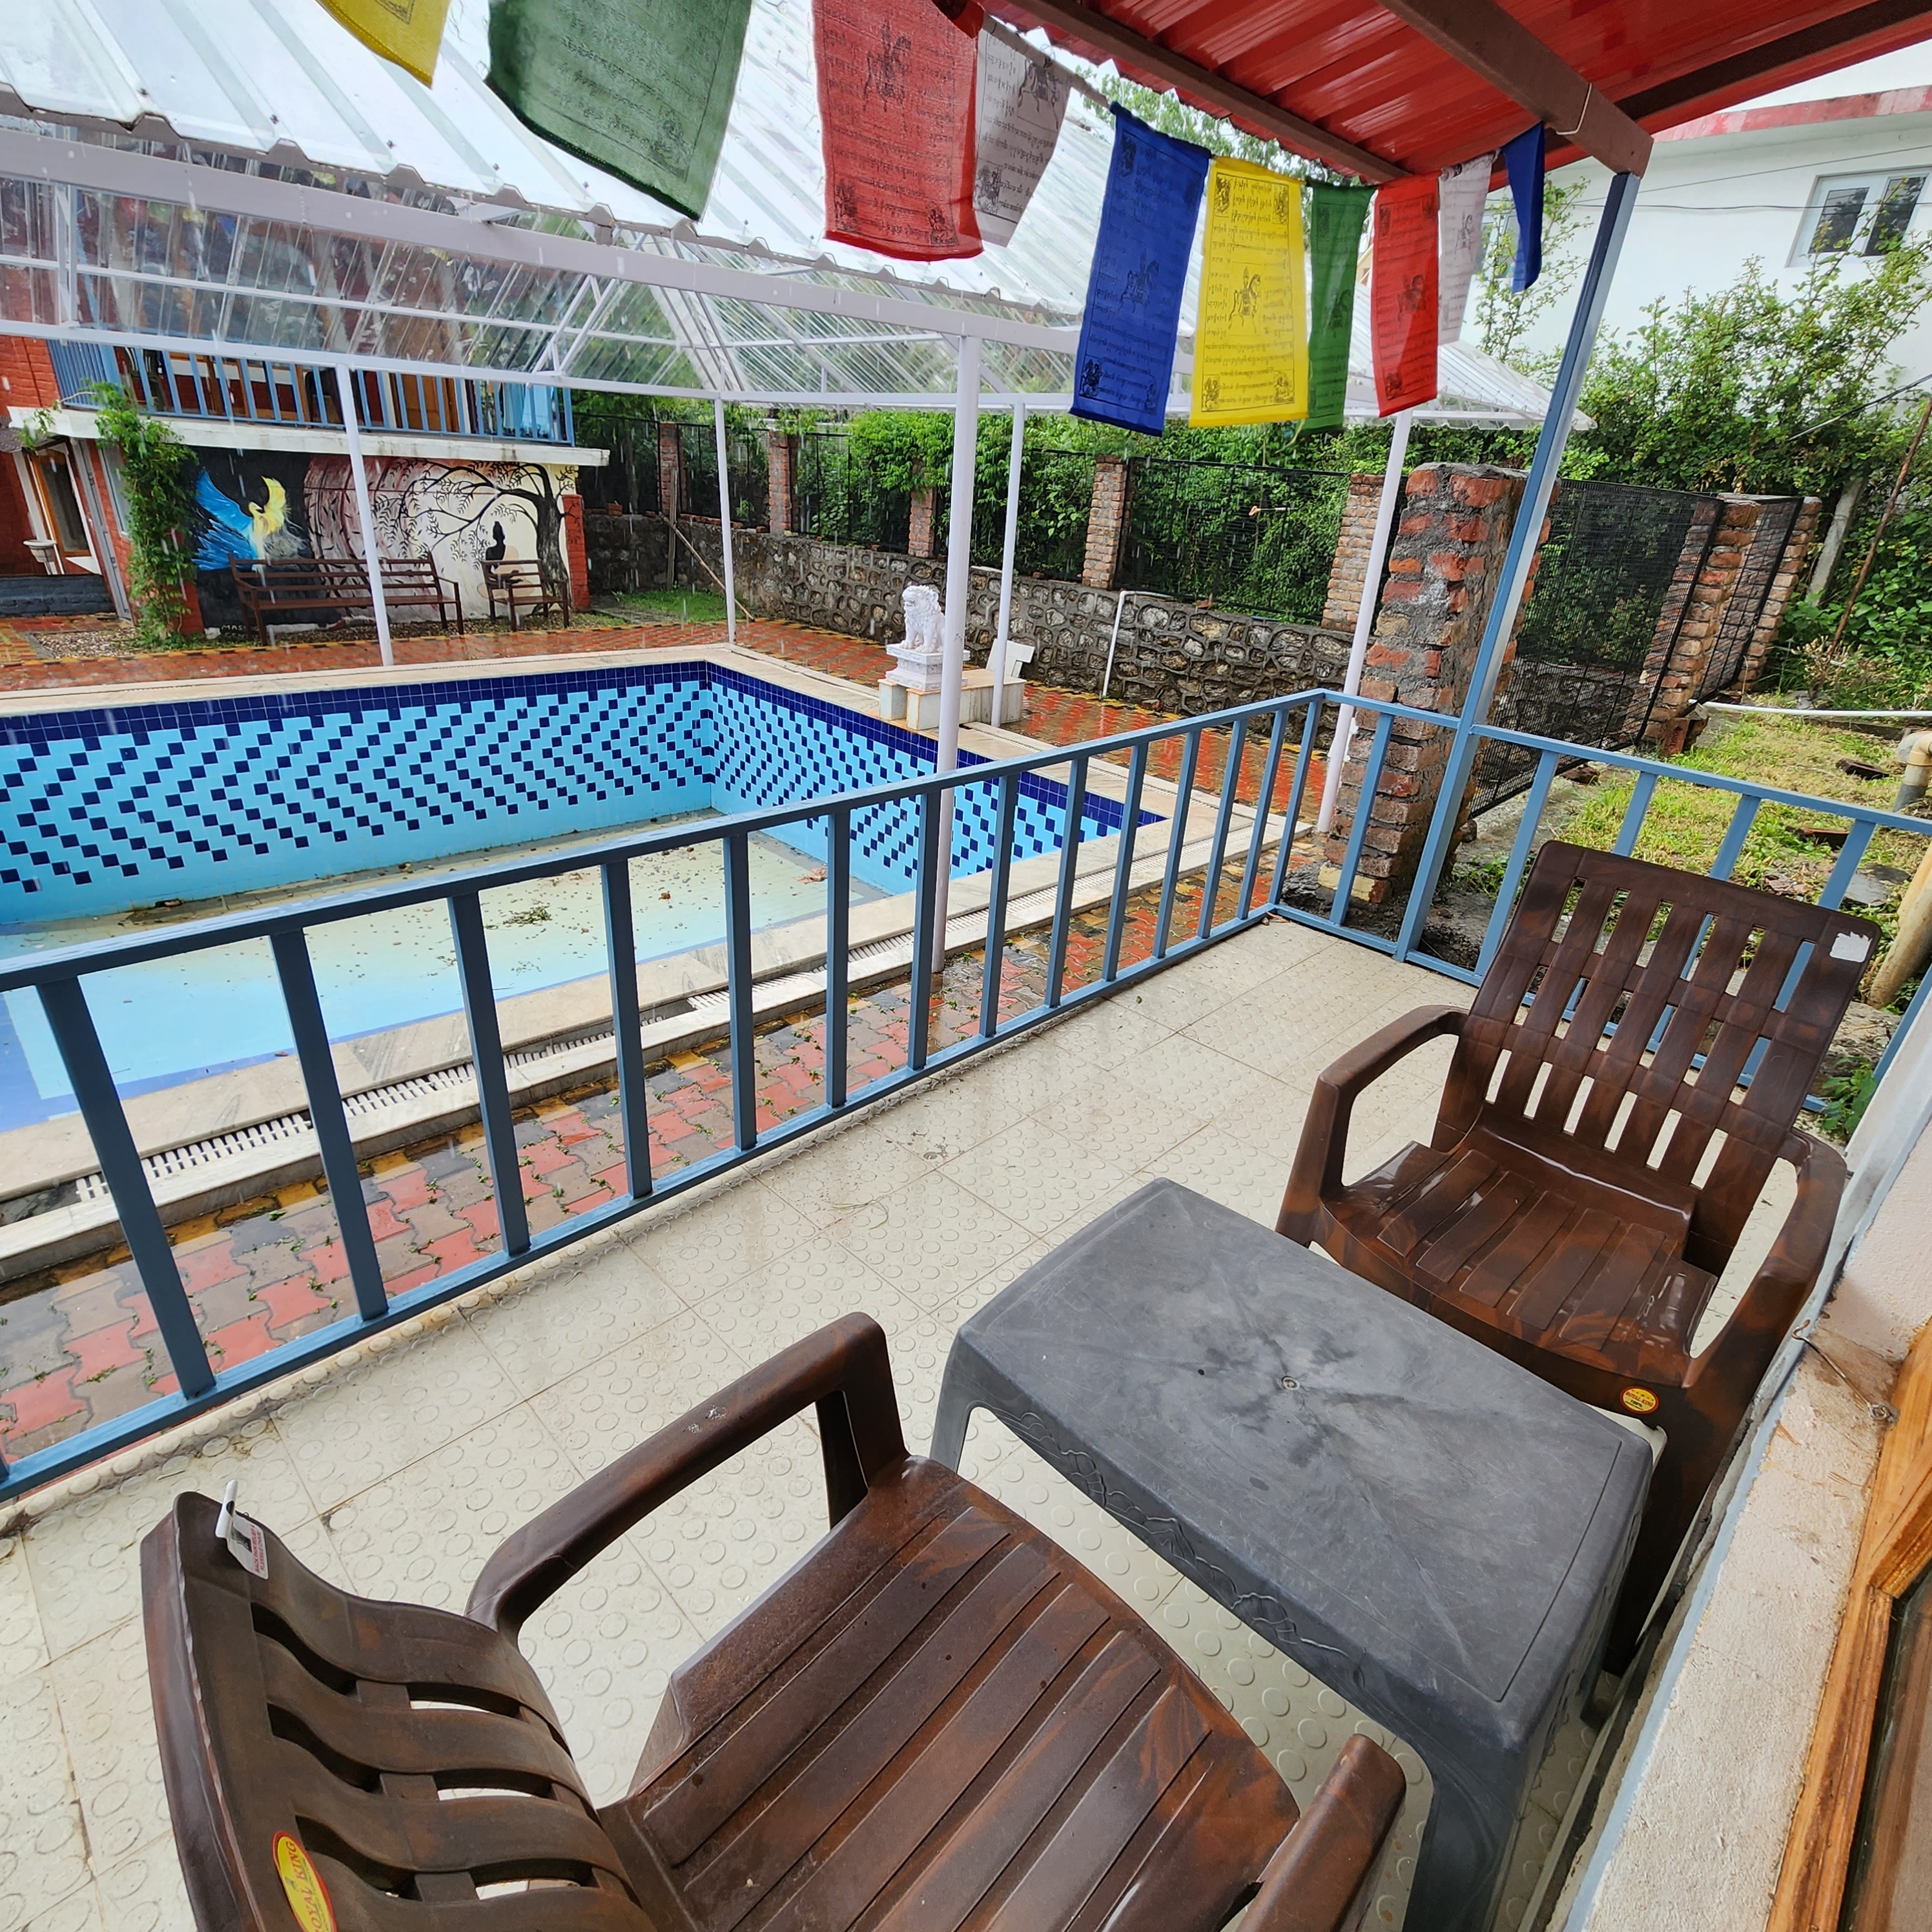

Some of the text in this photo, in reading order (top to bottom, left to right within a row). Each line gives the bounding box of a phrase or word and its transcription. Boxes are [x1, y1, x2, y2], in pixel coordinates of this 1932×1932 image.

[1625, 1392, 1654, 1407] ROYAL KING
[285, 1841, 305, 1880] KING
